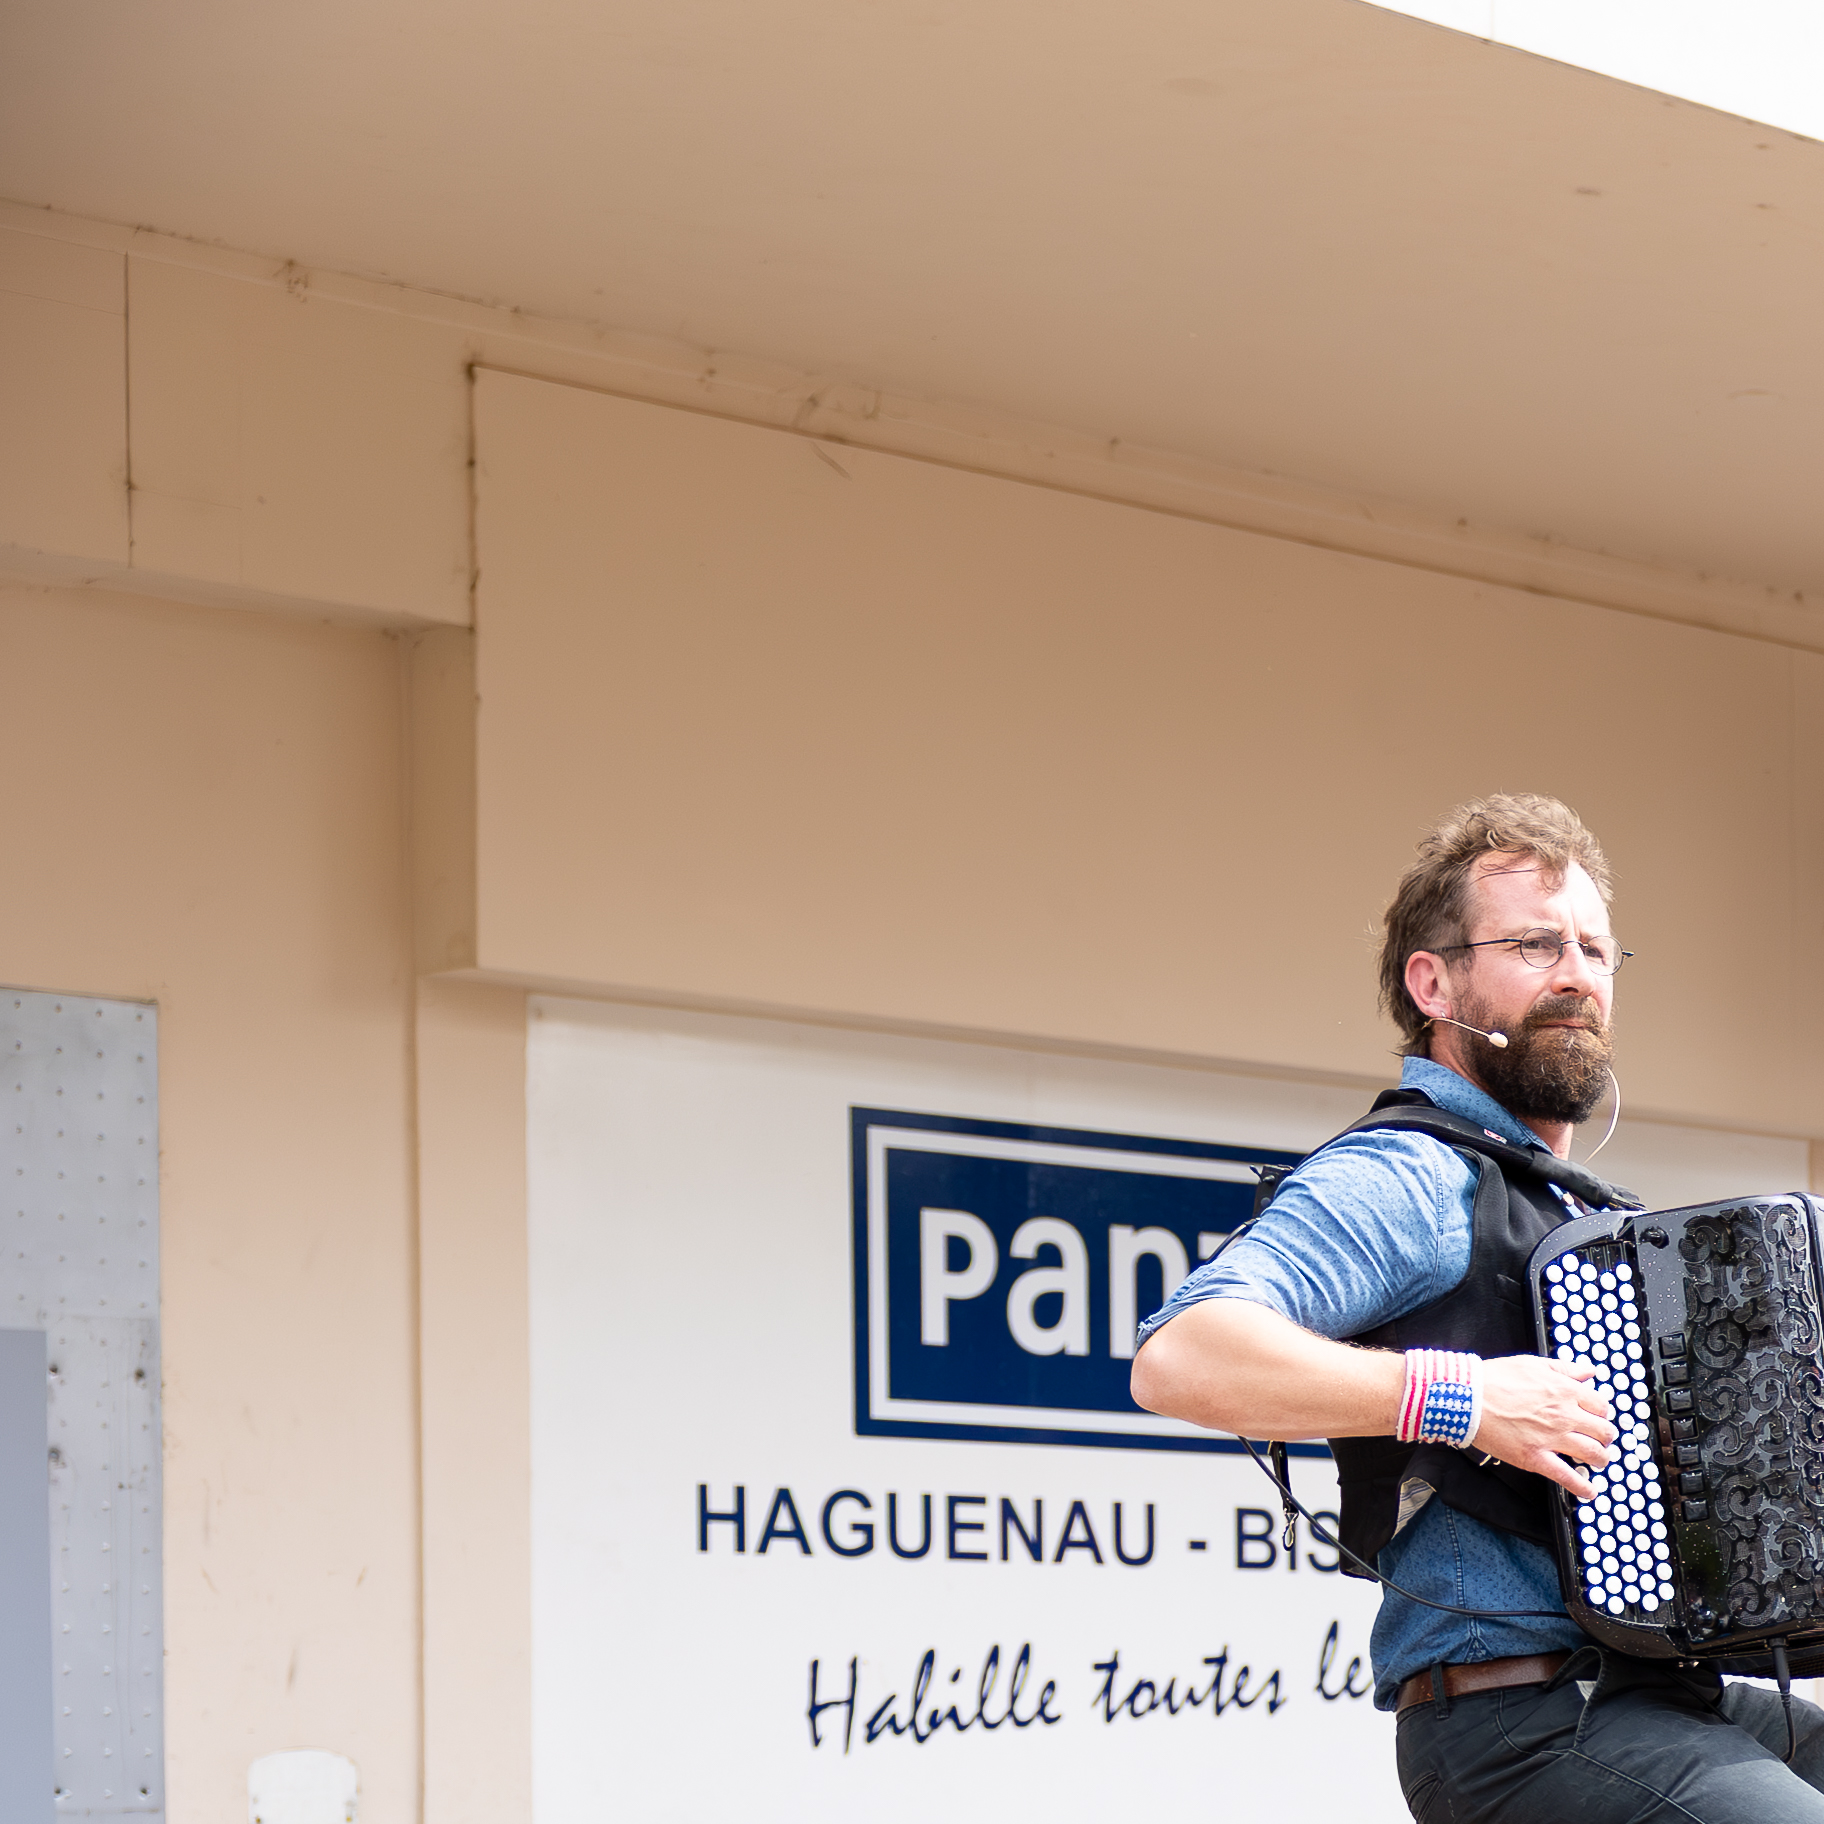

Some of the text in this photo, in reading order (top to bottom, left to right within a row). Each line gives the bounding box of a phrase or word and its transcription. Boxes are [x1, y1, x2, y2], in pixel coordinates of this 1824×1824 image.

[696, 1482, 1156, 1568] HAGUENAU
[805, 1641, 1063, 1754] Habille
[1091, 1644, 1288, 1725] toutes
